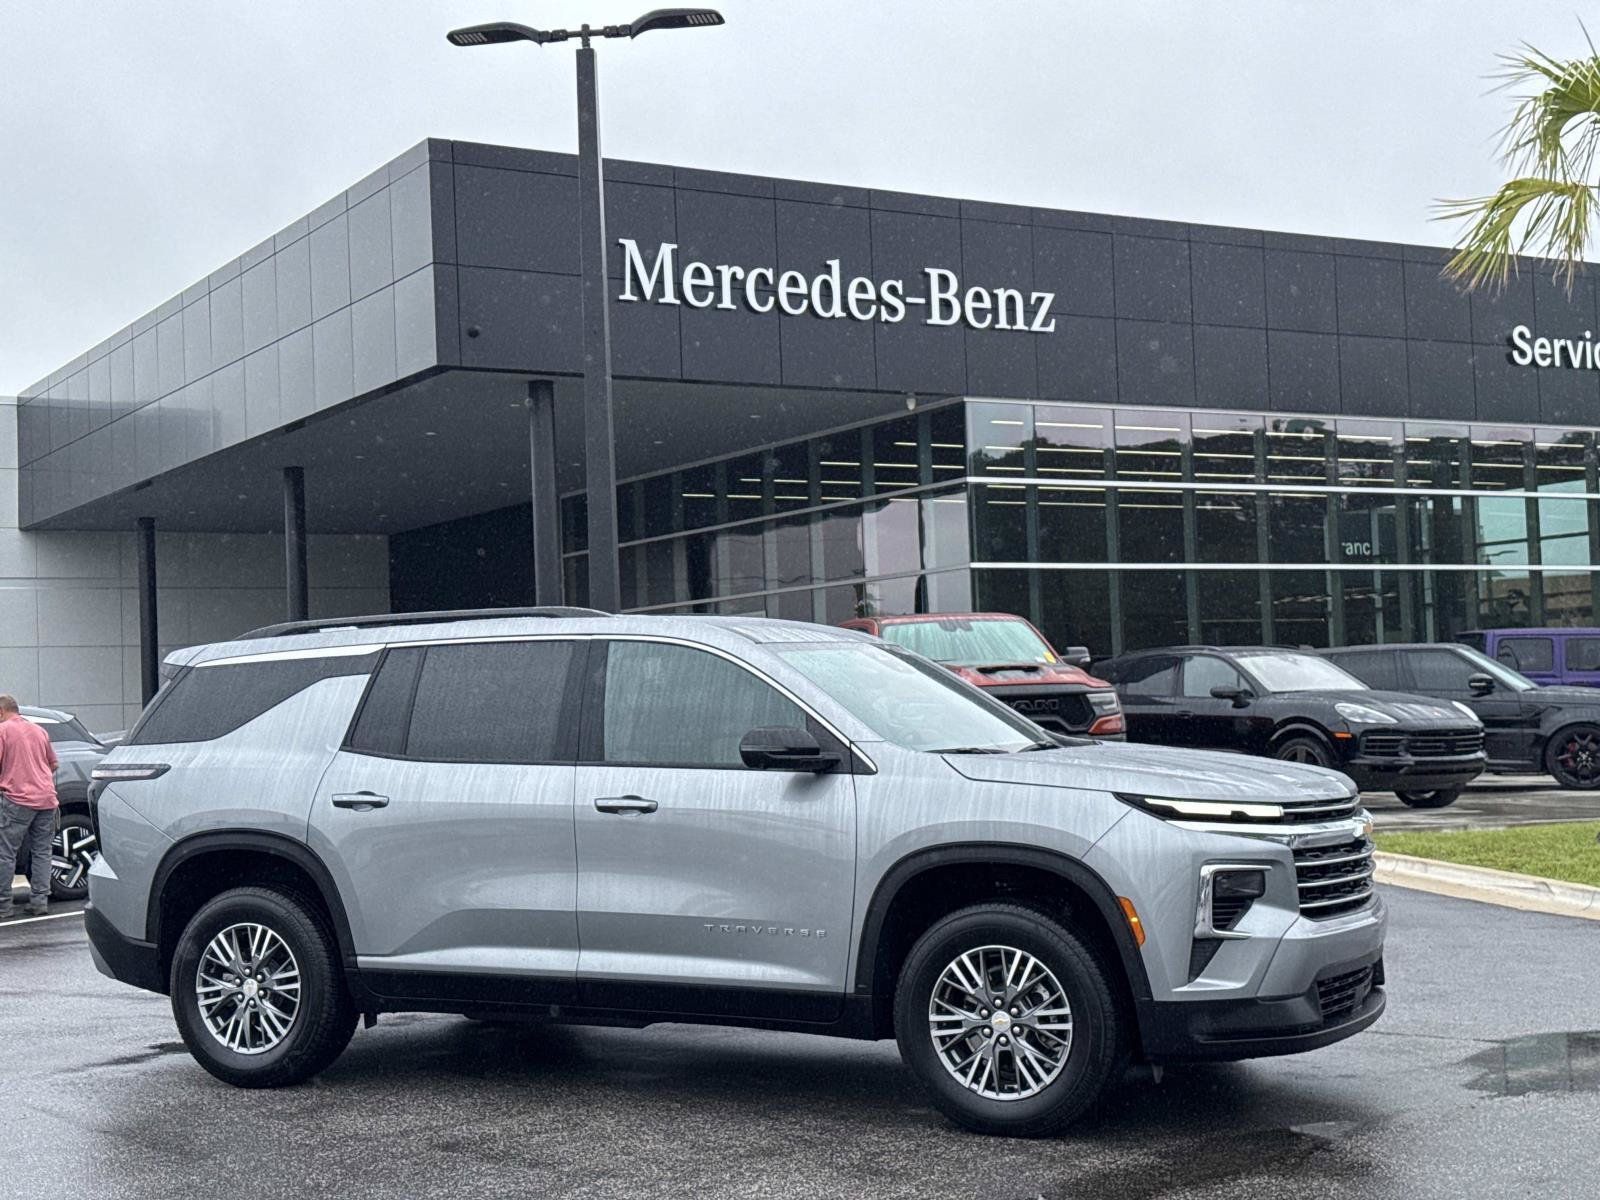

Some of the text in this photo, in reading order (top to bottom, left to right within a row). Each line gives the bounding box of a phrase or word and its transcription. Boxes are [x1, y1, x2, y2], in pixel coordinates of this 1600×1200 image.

[618, 238, 1056, 333] Mercedes-Benz
[1004, 699, 1059, 711] AM
[703, 924, 827, 937] TRAVERSE
